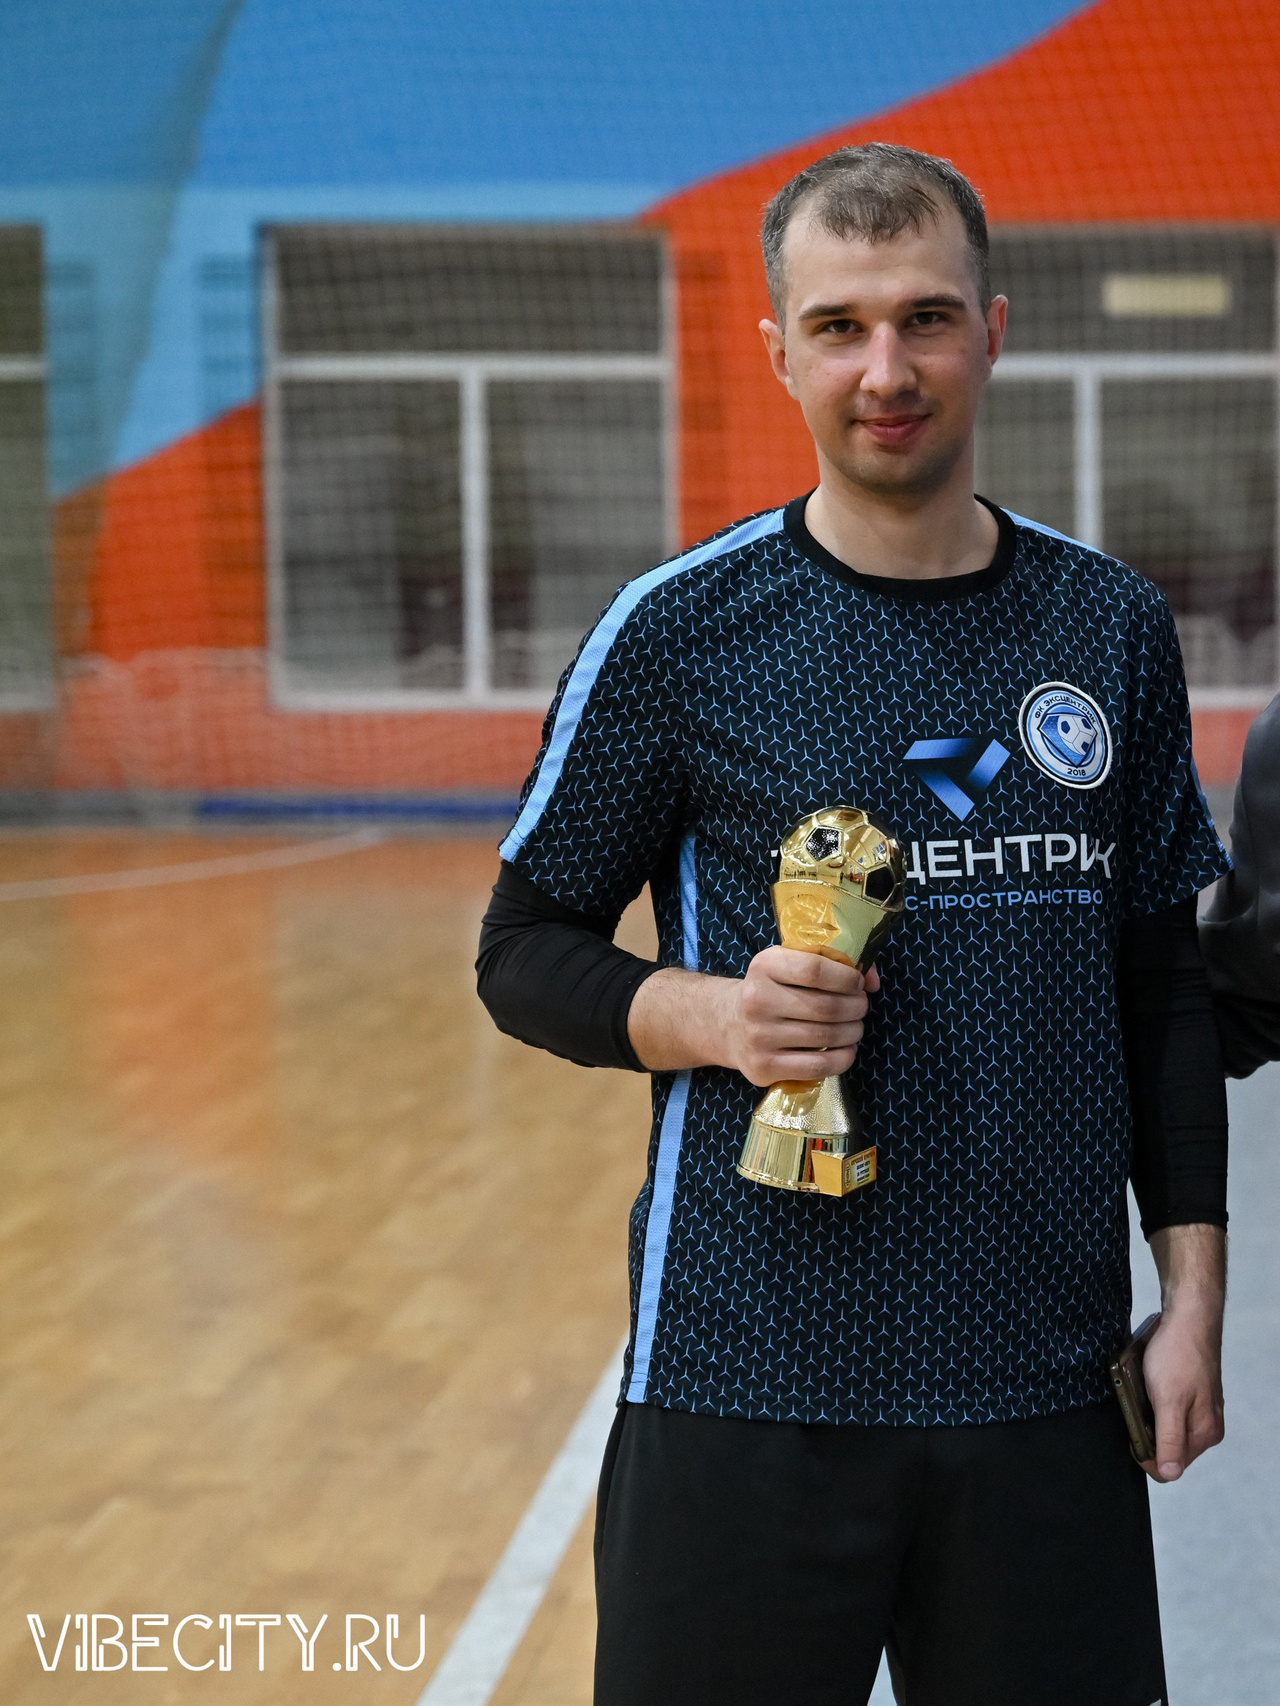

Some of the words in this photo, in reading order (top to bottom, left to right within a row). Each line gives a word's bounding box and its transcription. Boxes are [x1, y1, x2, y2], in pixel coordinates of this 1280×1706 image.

[1034, 706, 1045, 719] ФК
[1043, 695, 1096, 723] ЭКСЦЕНТРИК
[1067, 768, 1087, 777] 2018
[906, 833, 1117, 886] ЦЕНТРИК
[904, 888, 1103, 911] С-ПРОСТРАНСТВО
